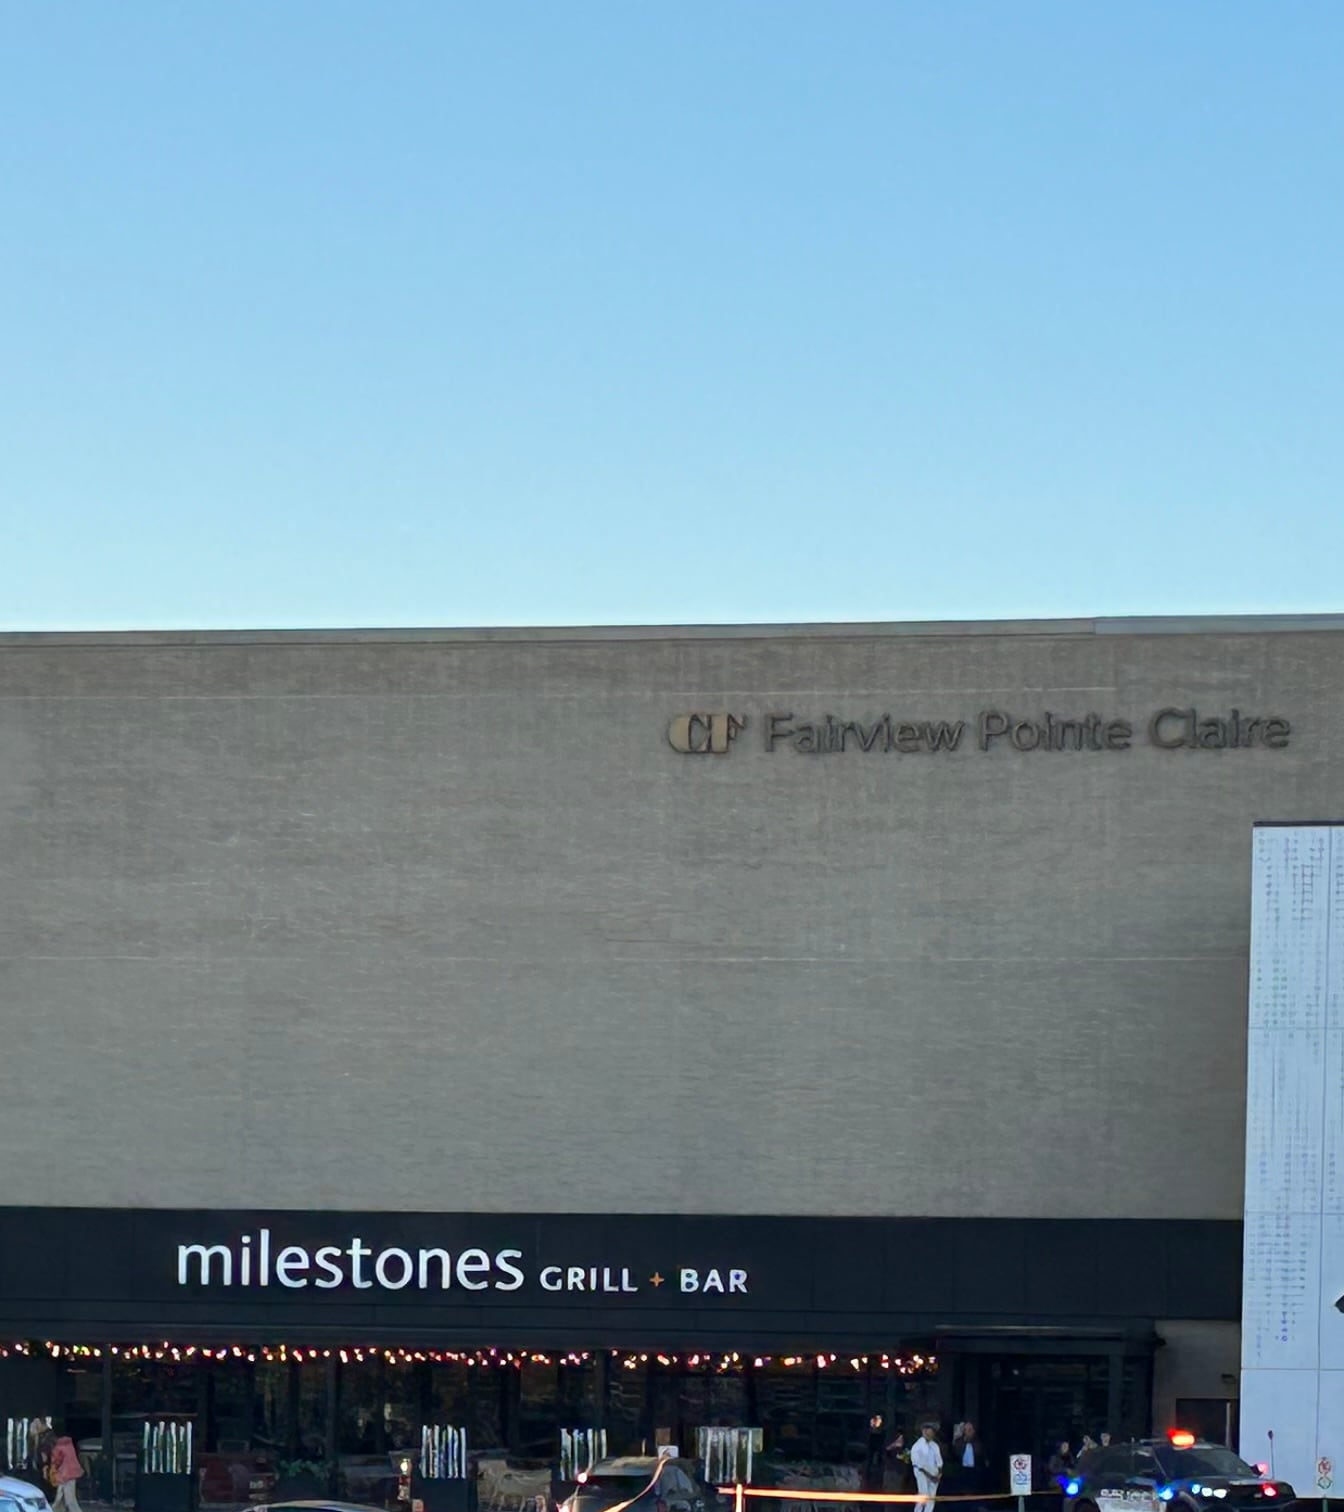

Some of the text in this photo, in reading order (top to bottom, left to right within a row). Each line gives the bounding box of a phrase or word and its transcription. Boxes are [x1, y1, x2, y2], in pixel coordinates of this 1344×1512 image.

[668, 707, 1291, 754] CF Fairview Pointe Claire
[177, 1229, 524, 1291] milestones
[539, 1266, 638, 1293] GRILL
[679, 1267, 749, 1293] BAR
